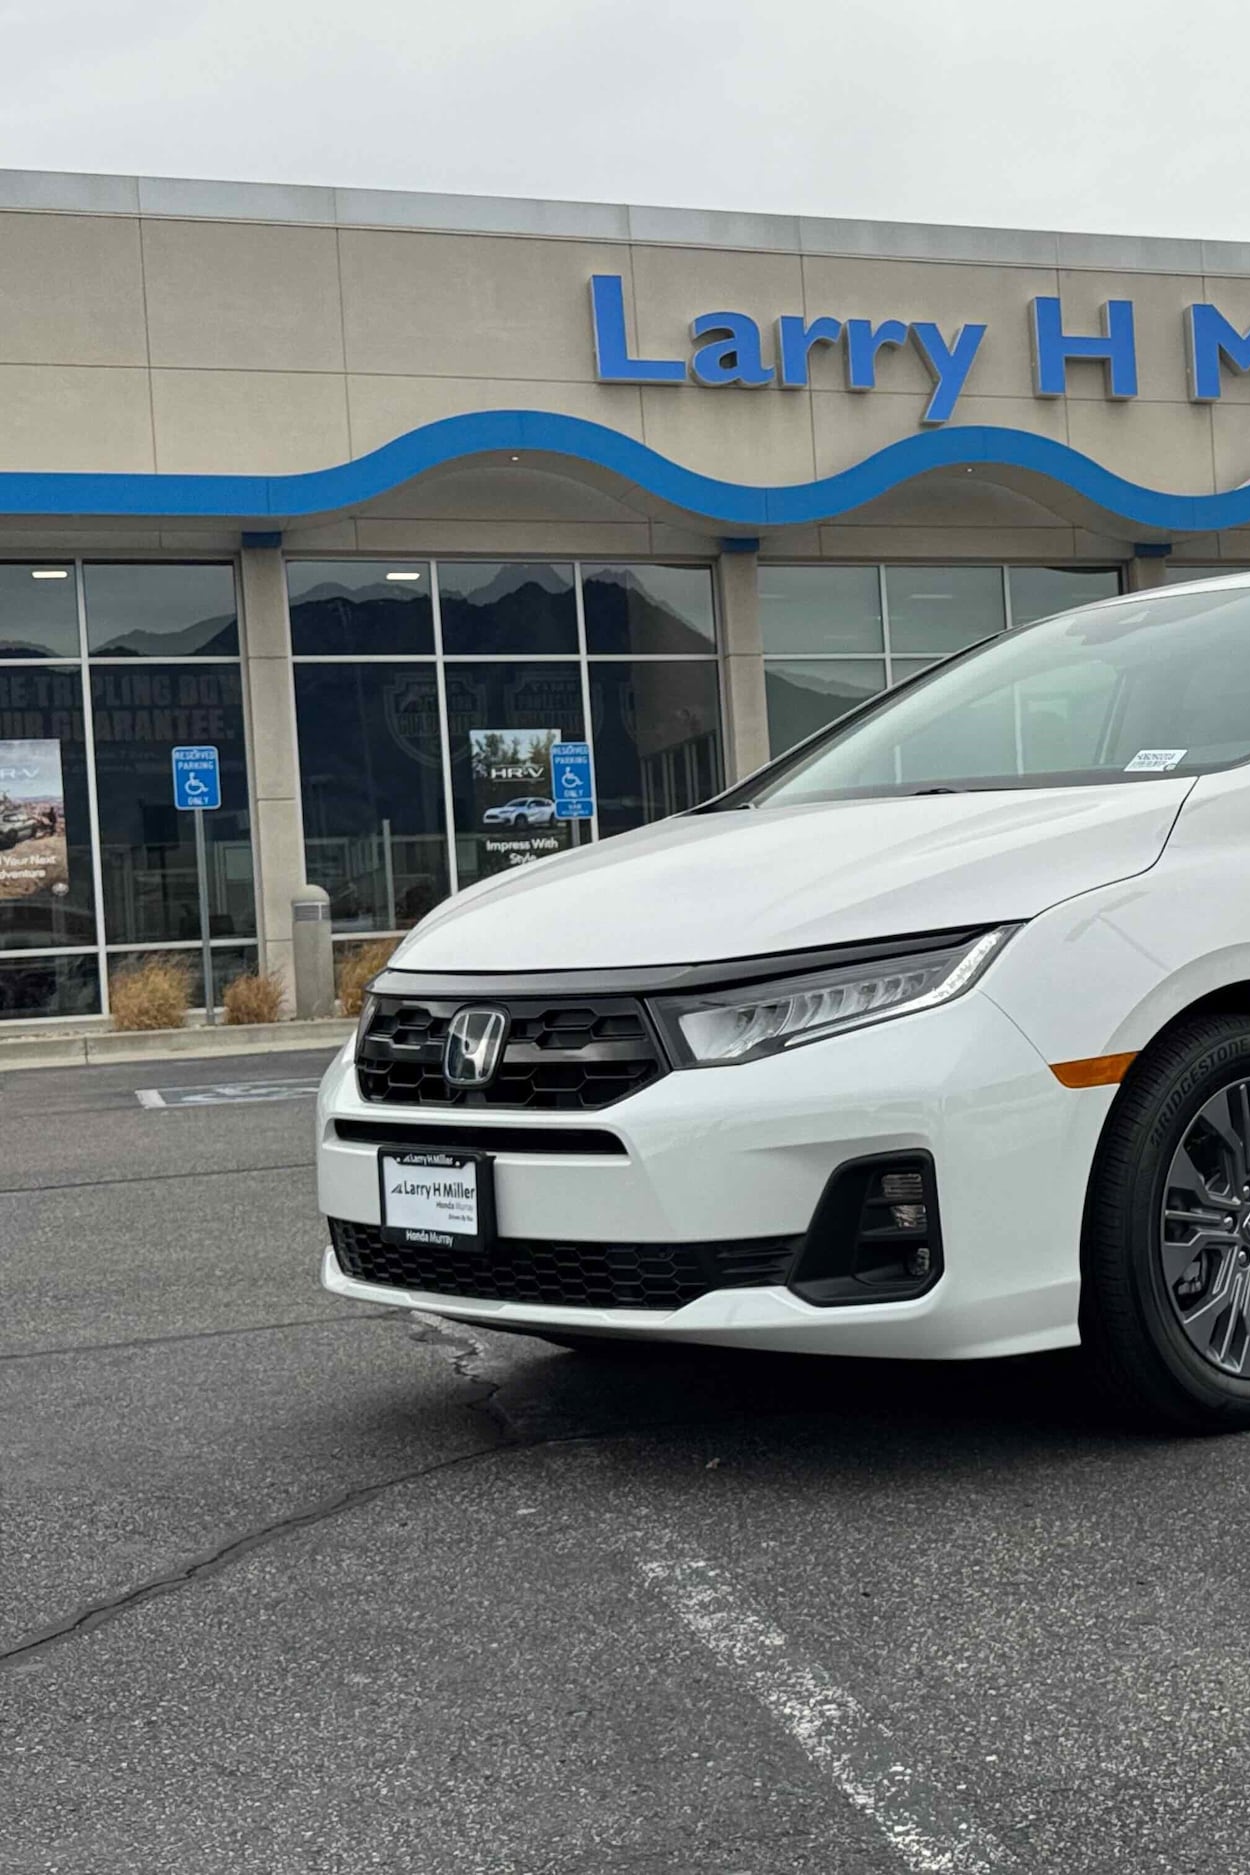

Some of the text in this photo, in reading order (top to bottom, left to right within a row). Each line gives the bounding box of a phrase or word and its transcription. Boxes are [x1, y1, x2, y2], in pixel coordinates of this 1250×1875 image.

[590, 274, 987, 425] Larry
[1028, 296, 1138, 401] H
[178, 761, 214, 770] PARKING
[555, 756, 588, 764] PARKING
[491, 767, 544, 779] HR-V
[564, 789, 583, 798] ONLY
[187, 796, 208, 805] ONLY
[486, 838, 559, 852] Impress With
[3, 855, 56, 866] Your Next
[1150, 1036, 1249, 1150] BRIDGESTONE
[404, 1180, 475, 1200] Larry H Miller
[406, 1229, 454, 1248] Honda Murray
